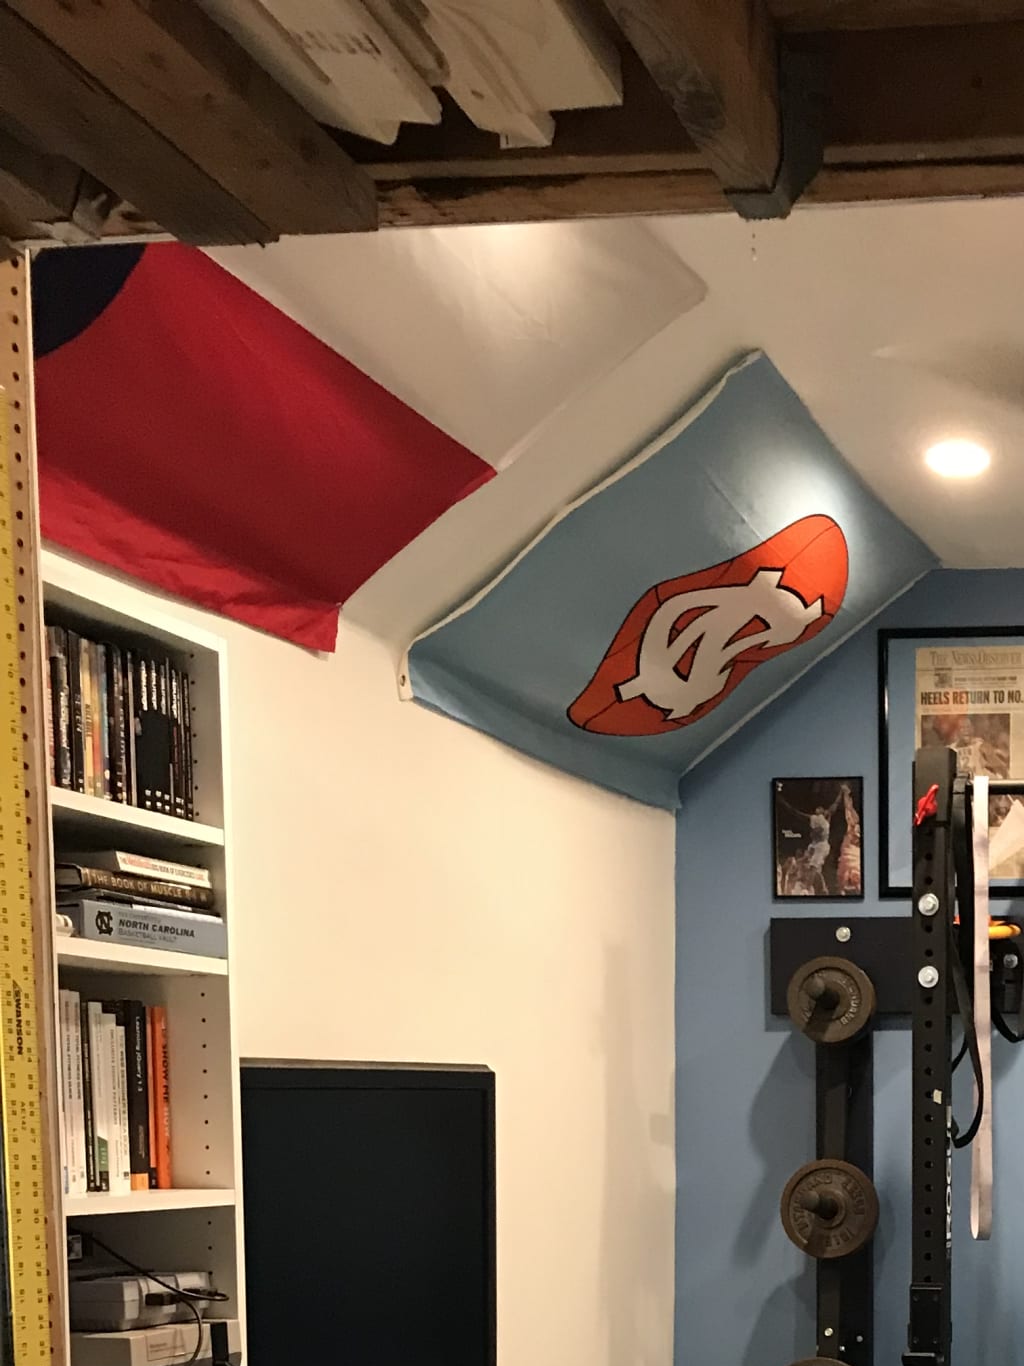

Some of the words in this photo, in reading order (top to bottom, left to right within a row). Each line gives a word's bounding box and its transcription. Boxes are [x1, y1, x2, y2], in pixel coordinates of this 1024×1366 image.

[921, 691, 950, 705] HEELS
[952, 690, 990, 705] RETURN
[993, 690, 1005, 704] TO
[1007, 690, 1024, 704] NO.
[93, 874, 109, 885] THE
[111, 876, 136, 890] BOOK
[137, 881, 150, 892] OF
[151, 885, 182, 898] MUSCLE
[118, 918, 149, 931] NORTH
[152, 923, 195, 938] CAROLINA
[15, 988, 23, 1056] SWANSON
[135, 1016, 143, 1051] Learning
